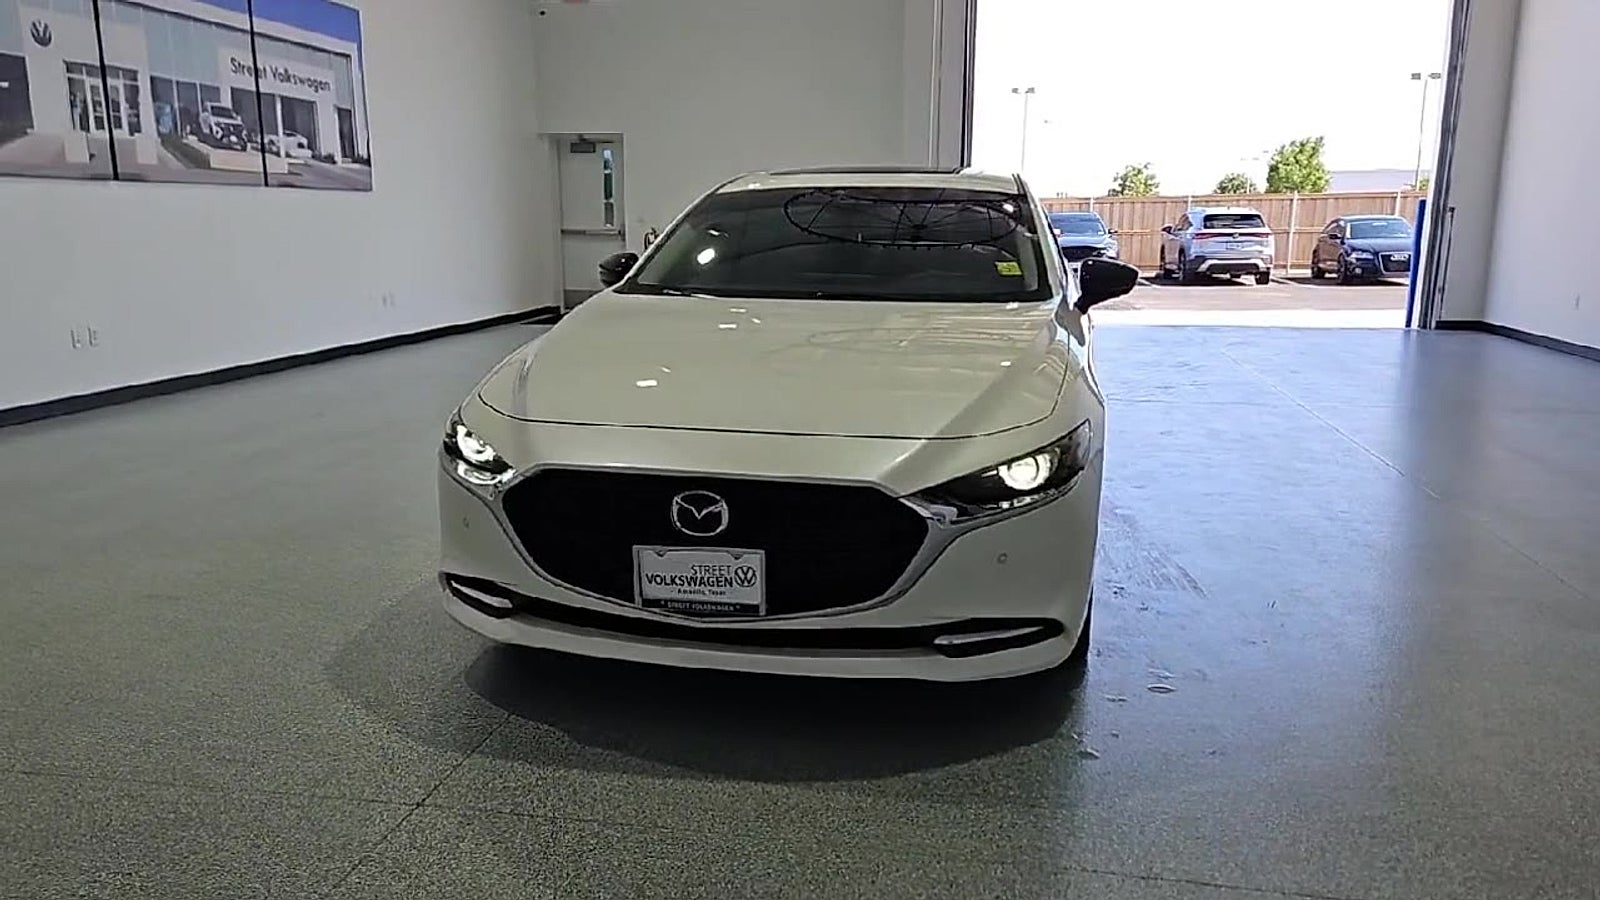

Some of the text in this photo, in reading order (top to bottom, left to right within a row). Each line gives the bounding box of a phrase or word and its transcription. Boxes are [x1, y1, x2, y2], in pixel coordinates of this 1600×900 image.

[269, 65, 331, 93] Volkswagen
[690, 564, 732, 576] STREET
[645, 573, 733, 588] VOLKSWAGEN
